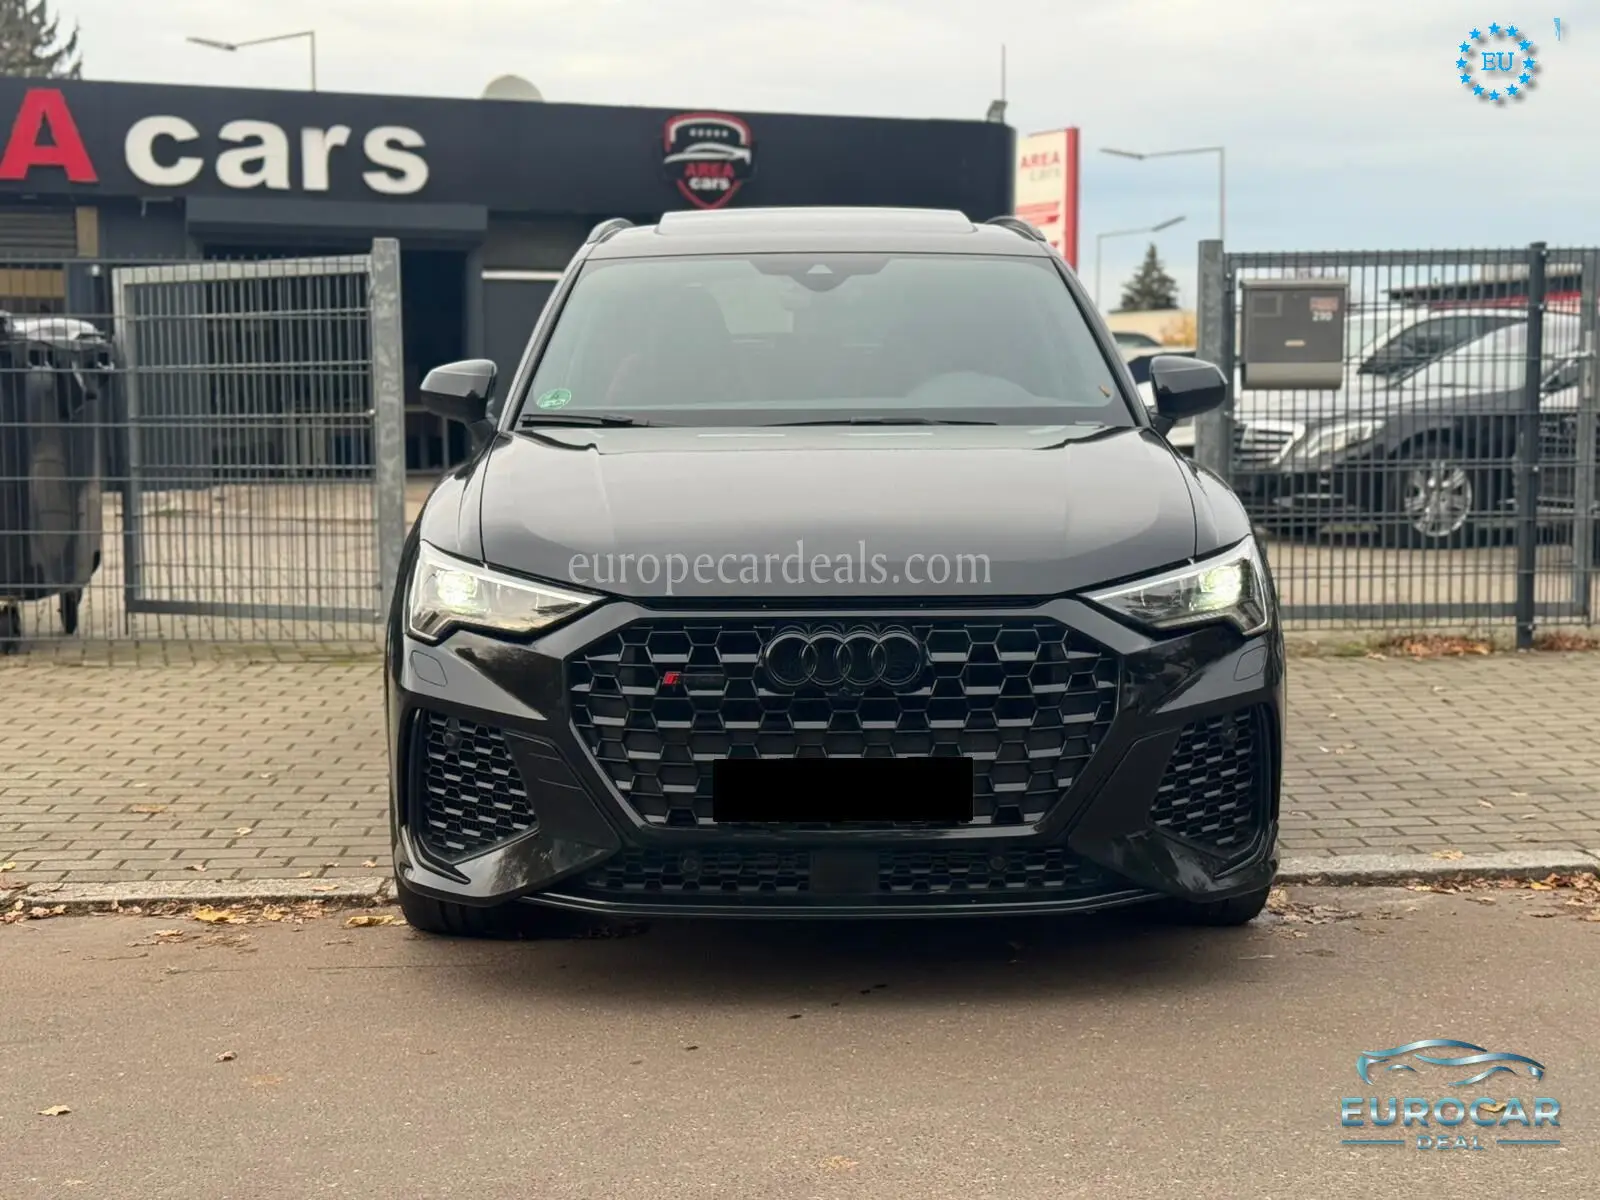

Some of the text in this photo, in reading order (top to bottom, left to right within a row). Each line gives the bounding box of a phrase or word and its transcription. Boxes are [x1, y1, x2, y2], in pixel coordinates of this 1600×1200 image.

[124, 114, 430, 195] cars
[1020, 151, 1061, 169] AREA
[684, 161, 735, 177] AREA
[687, 177, 731, 191] cars
